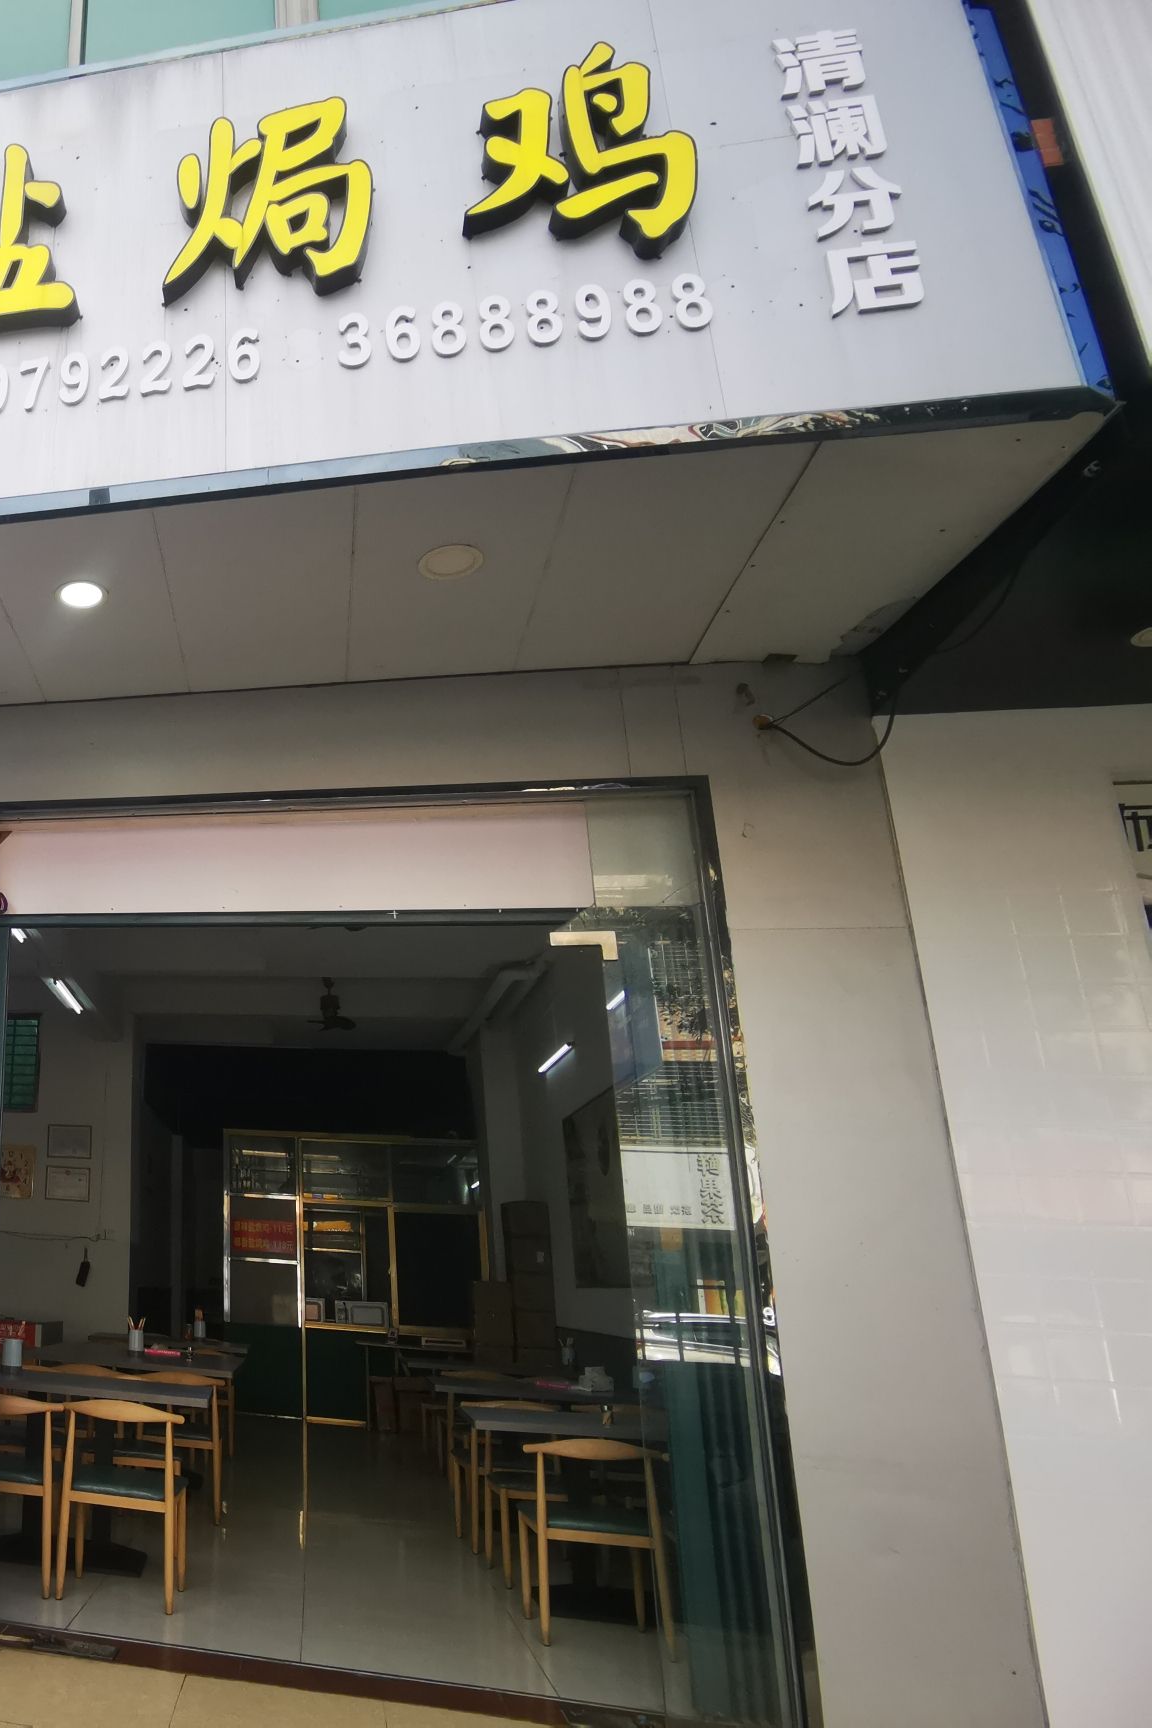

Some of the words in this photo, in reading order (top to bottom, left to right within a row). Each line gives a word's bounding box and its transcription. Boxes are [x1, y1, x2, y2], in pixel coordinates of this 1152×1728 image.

[771, 28, 926, 319] 清澜分店
[338, 273, 714, 369] 36888988
